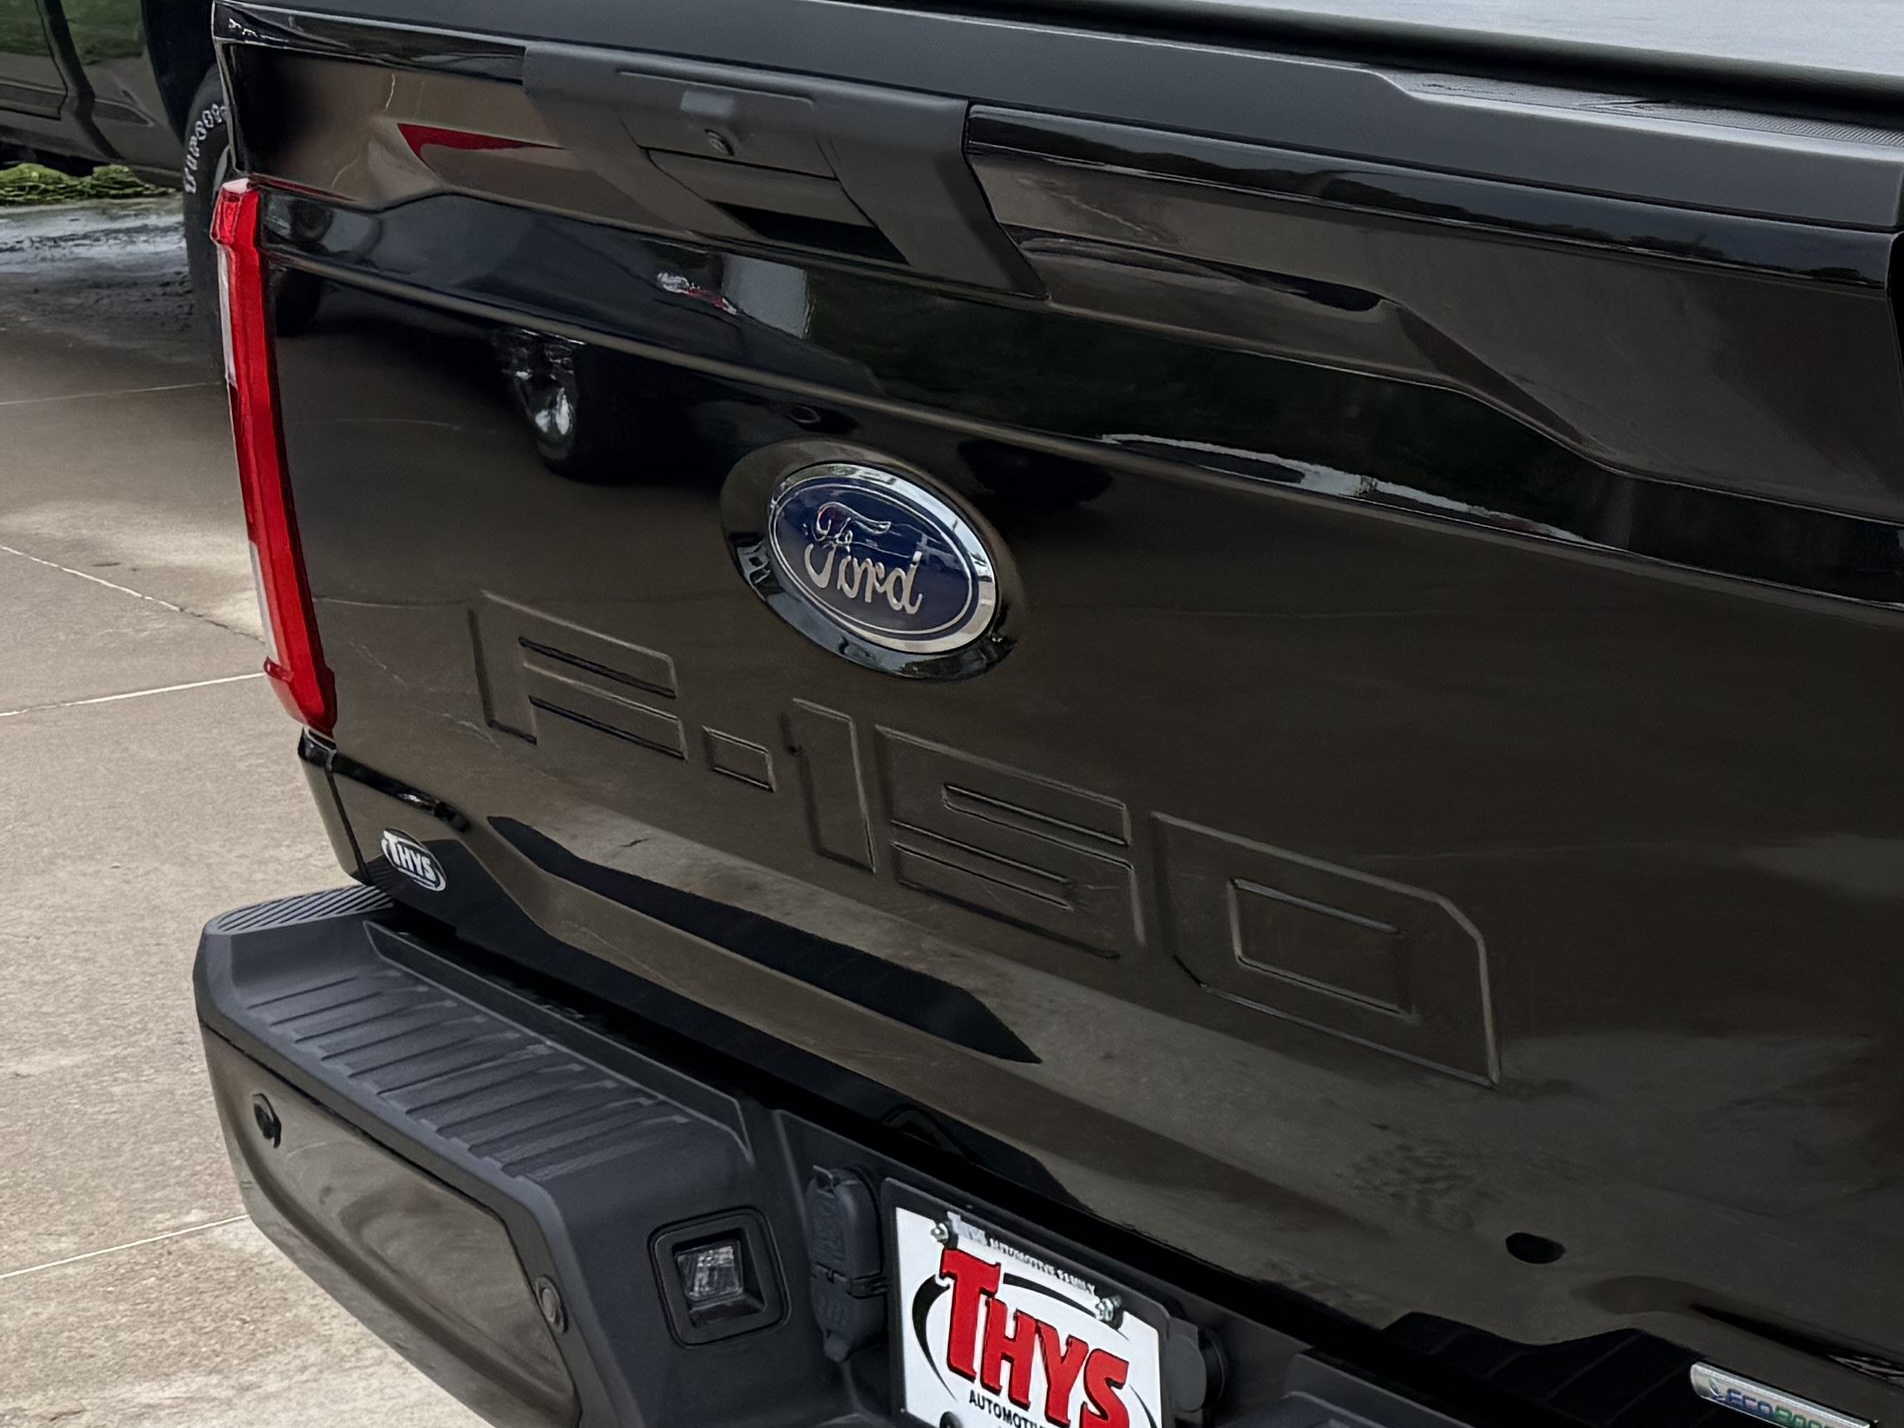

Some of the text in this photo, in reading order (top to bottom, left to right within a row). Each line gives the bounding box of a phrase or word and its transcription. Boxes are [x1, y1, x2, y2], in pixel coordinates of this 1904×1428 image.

[804, 501, 924, 616] Ford
[382, 829, 438, 882] THYS
[466, 588, 1502, 1090] F-150
